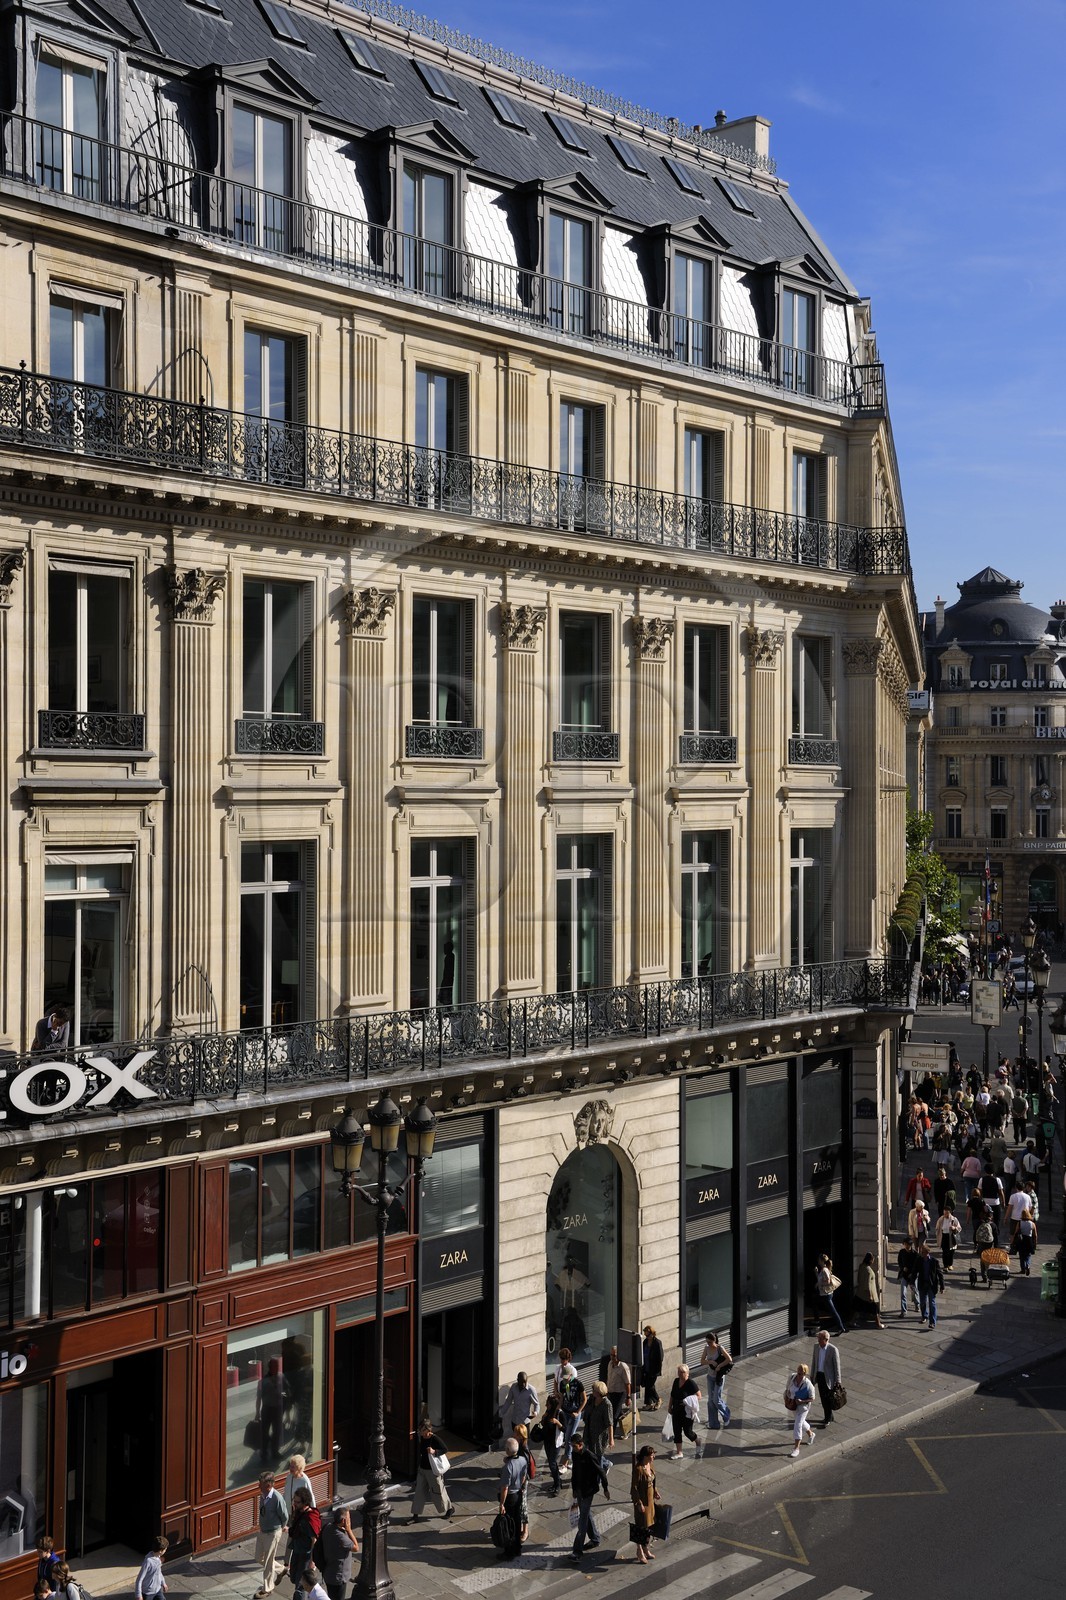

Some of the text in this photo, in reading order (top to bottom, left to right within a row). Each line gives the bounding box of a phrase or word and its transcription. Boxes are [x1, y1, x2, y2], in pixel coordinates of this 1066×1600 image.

[970, 679, 1017, 689] royal
[1022, 679, 1045, 688] air
[911, 1061, 939, 1069] Change
[0, 1050, 158, 1119] OX
[813, 1160, 832, 1174] ZARA
[757, 1173, 778, 1189] ZARA
[698, 1188, 720, 1204] ZARA
[563, 1213, 588, 1230] ZARA
[440, 1249, 469, 1268] ZARA
